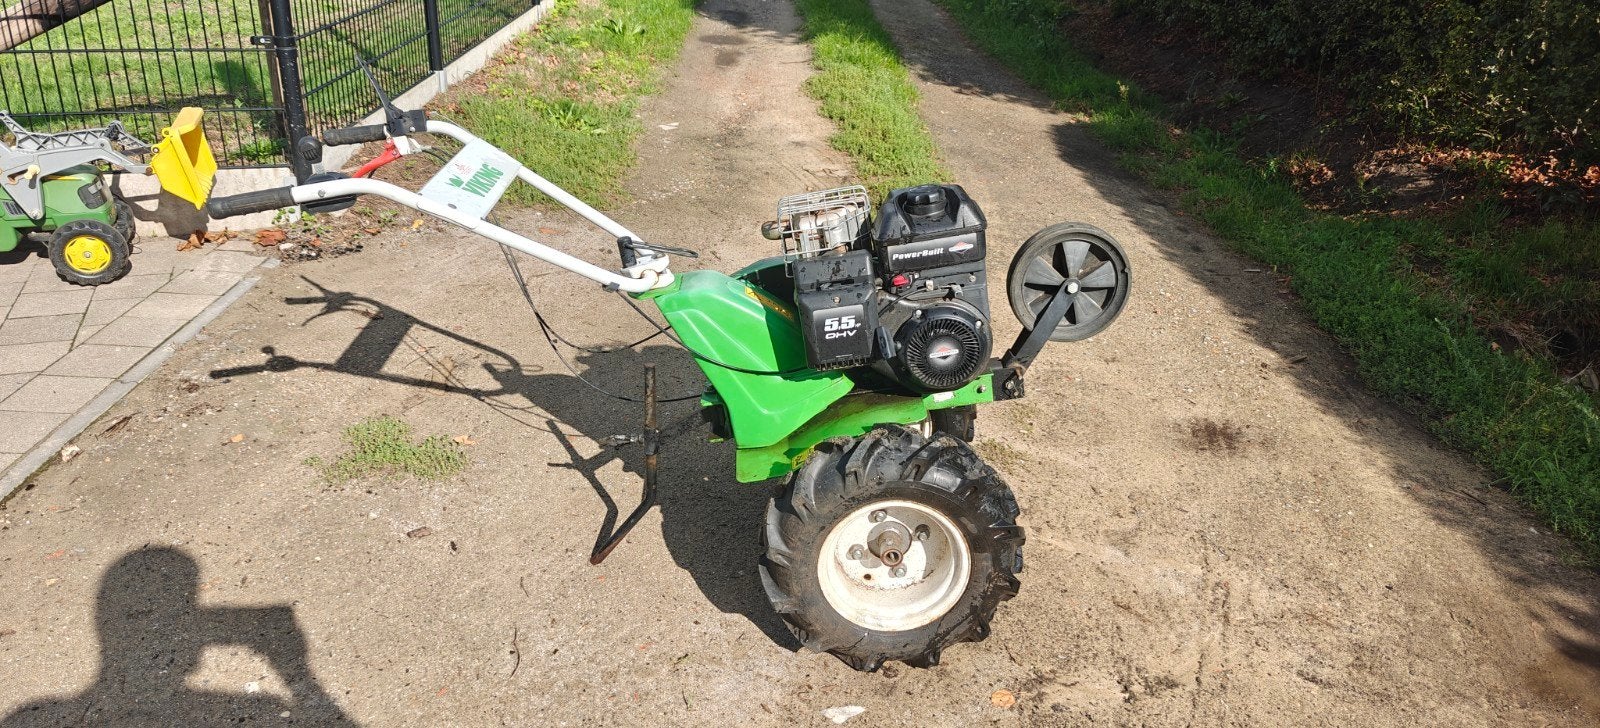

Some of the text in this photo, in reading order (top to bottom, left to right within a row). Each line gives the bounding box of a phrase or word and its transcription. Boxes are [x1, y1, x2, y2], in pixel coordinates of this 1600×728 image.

[461, 163, 504, 197] VIKING
[892, 247, 944, 261] PowerBuilt
[825, 329, 857, 340] OHV
